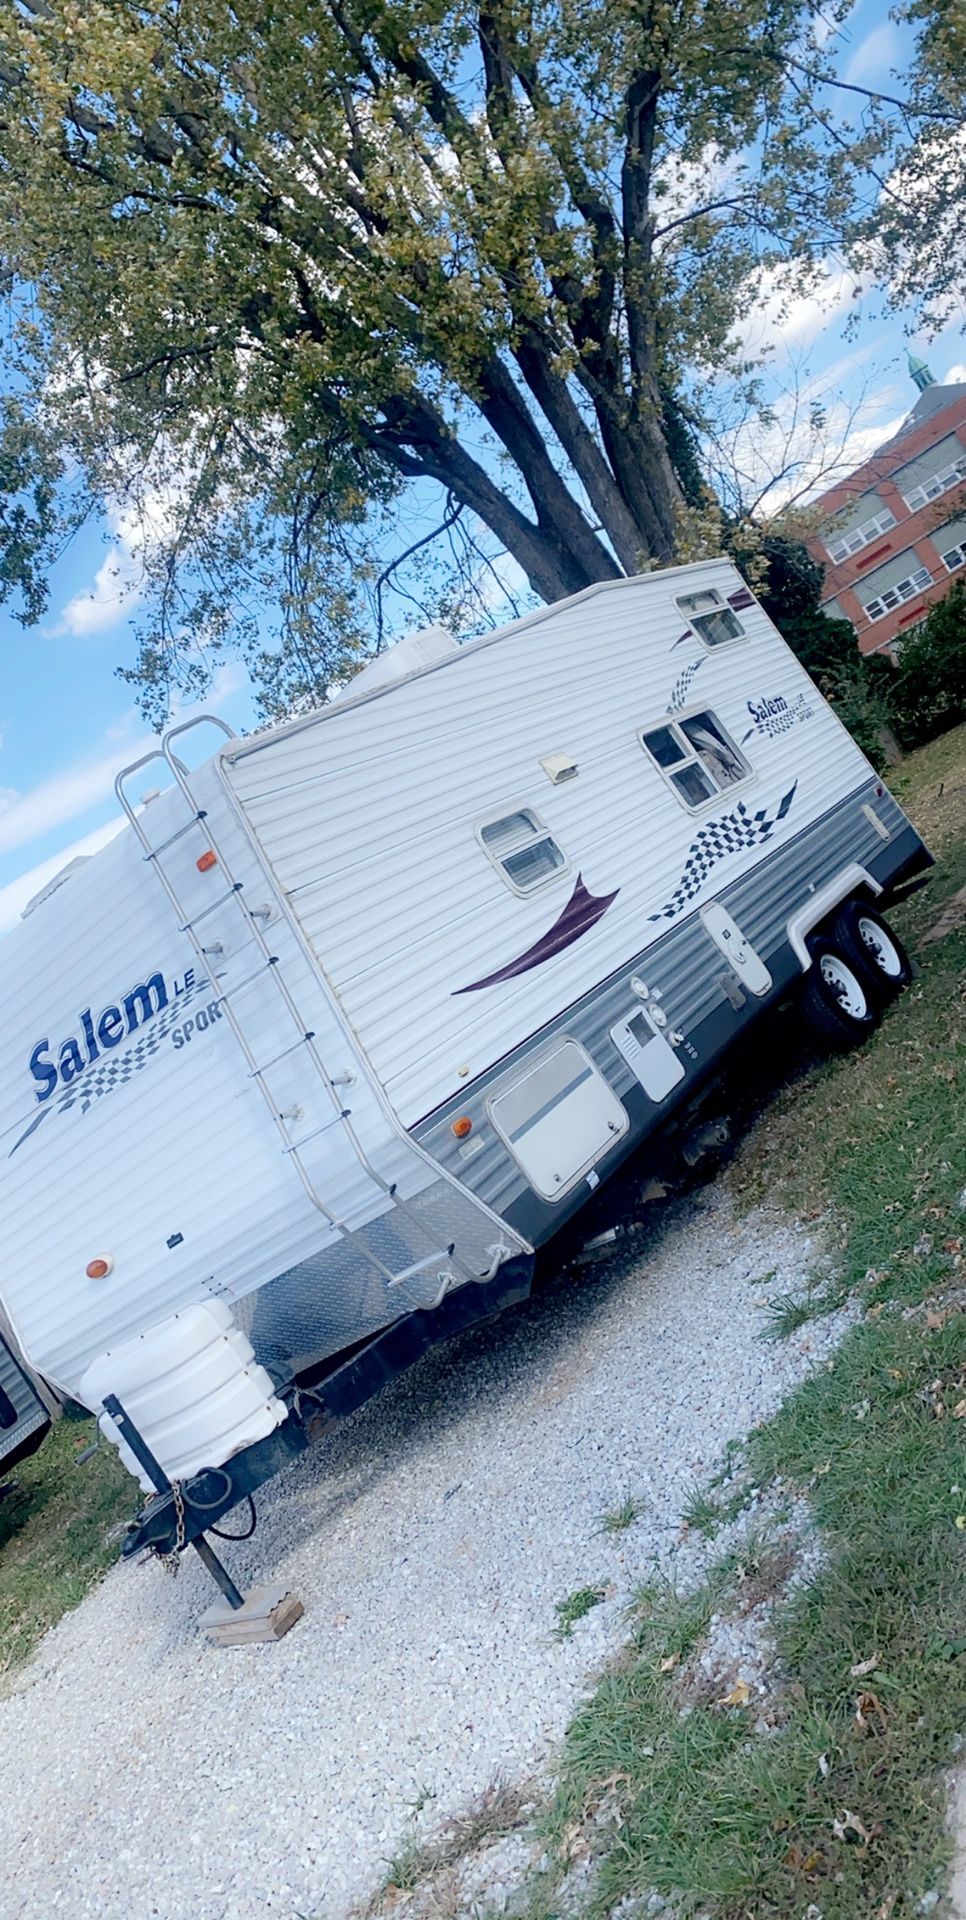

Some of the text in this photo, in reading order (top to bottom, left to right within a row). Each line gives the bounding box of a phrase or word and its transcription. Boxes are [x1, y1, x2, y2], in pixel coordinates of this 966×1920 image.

[747, 697, 788, 723] Salem
[28, 967, 196, 1104] Salem LE
[171, 999, 224, 1050] SPOR
